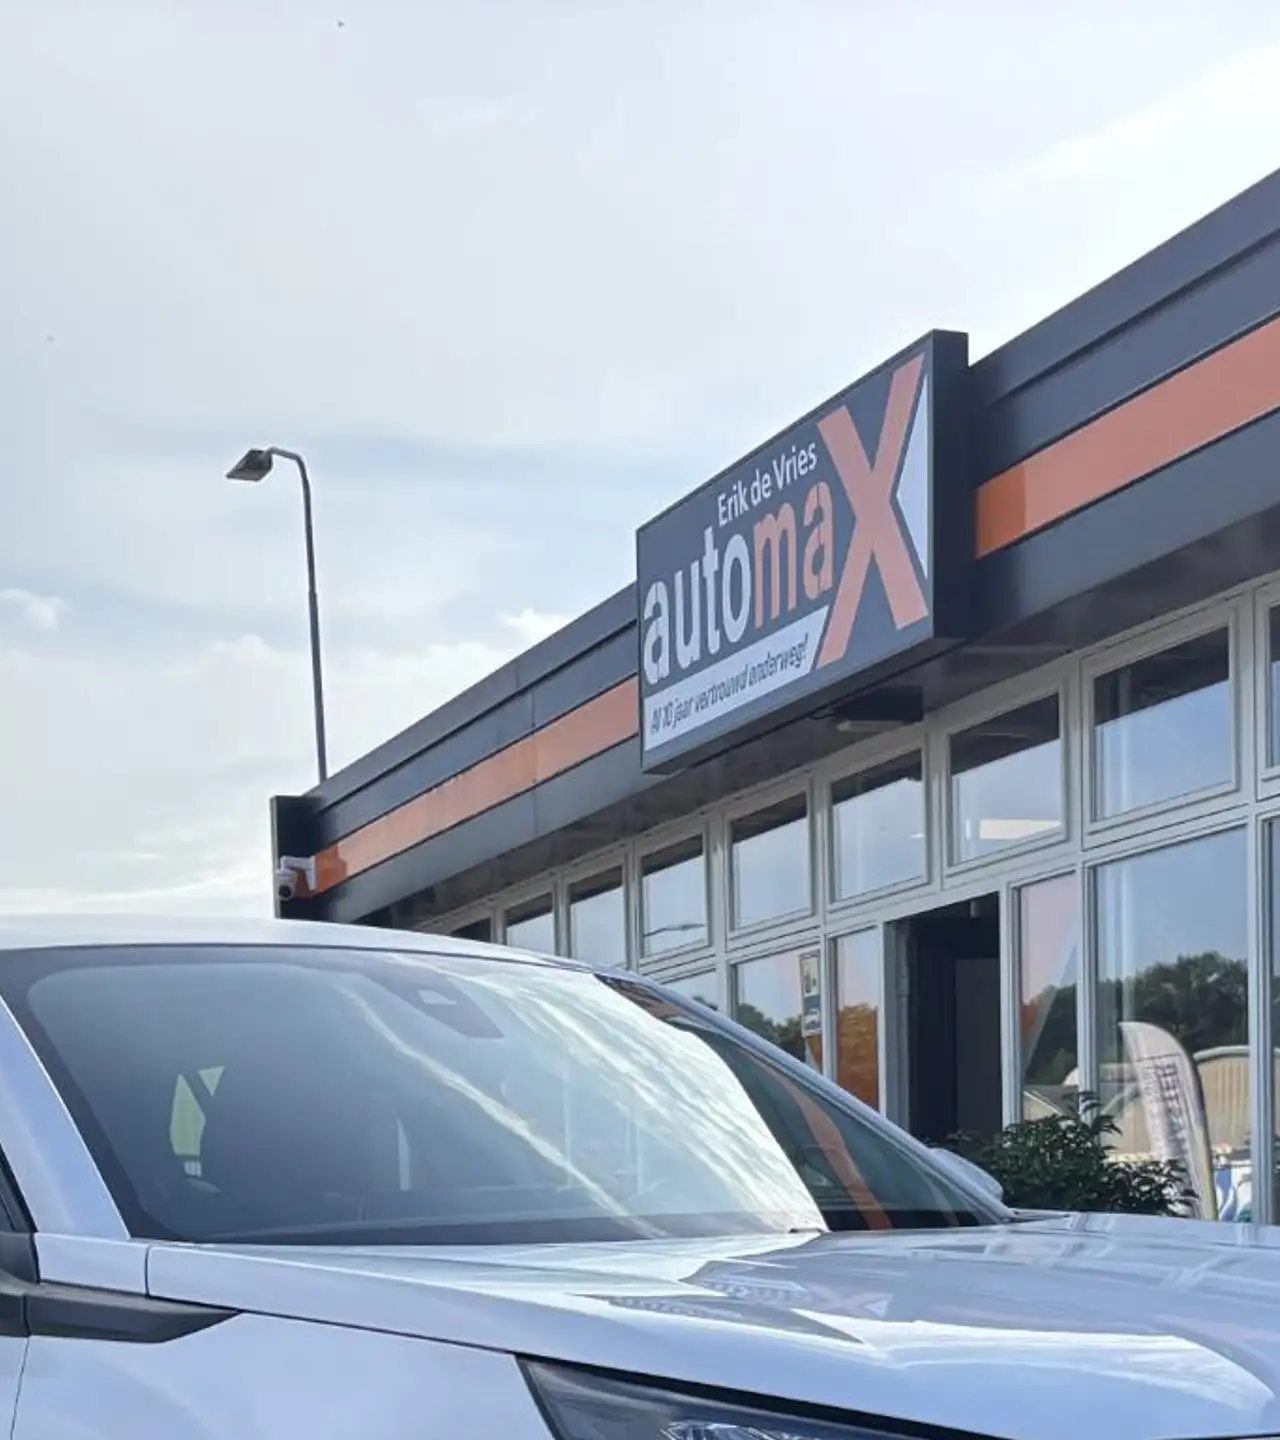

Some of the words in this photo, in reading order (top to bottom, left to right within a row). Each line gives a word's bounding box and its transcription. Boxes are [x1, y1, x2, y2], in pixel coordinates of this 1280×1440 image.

[642, 352, 927, 685] automaX
[718, 480, 749, 527] Erik
[750, 468, 773, 507] de
[771, 442, 818, 491] Vries
